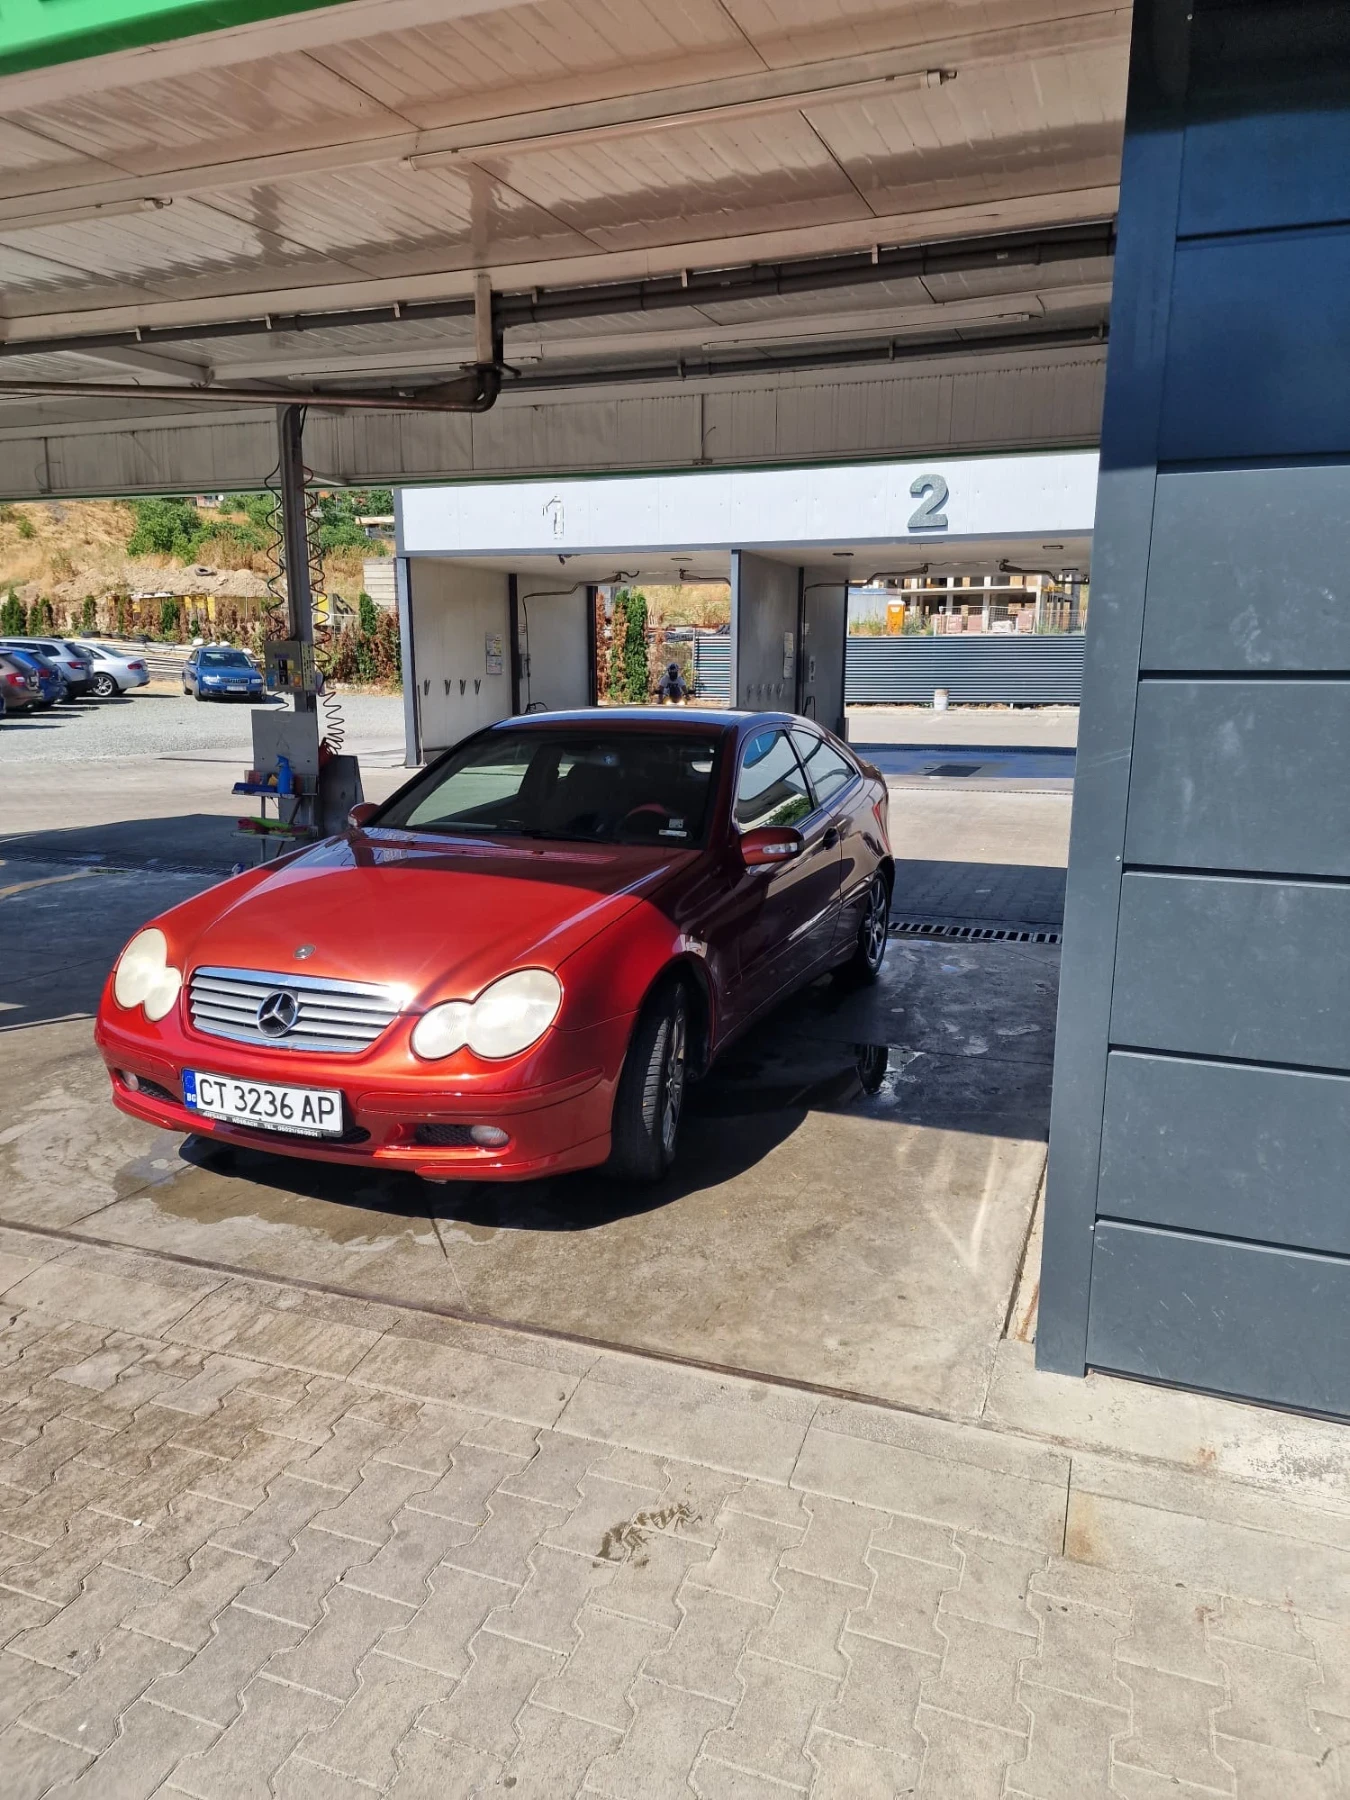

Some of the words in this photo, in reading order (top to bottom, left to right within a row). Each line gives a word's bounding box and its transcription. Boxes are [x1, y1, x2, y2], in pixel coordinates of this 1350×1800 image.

[541, 493, 565, 541] 1
[907, 473, 949, 533] 2
[186, 1092, 197, 1103] BG
[199, 1078, 227, 1109] CT
[234, 1085, 294, 1120] 3236
[301, 1094, 335, 1124] AP
